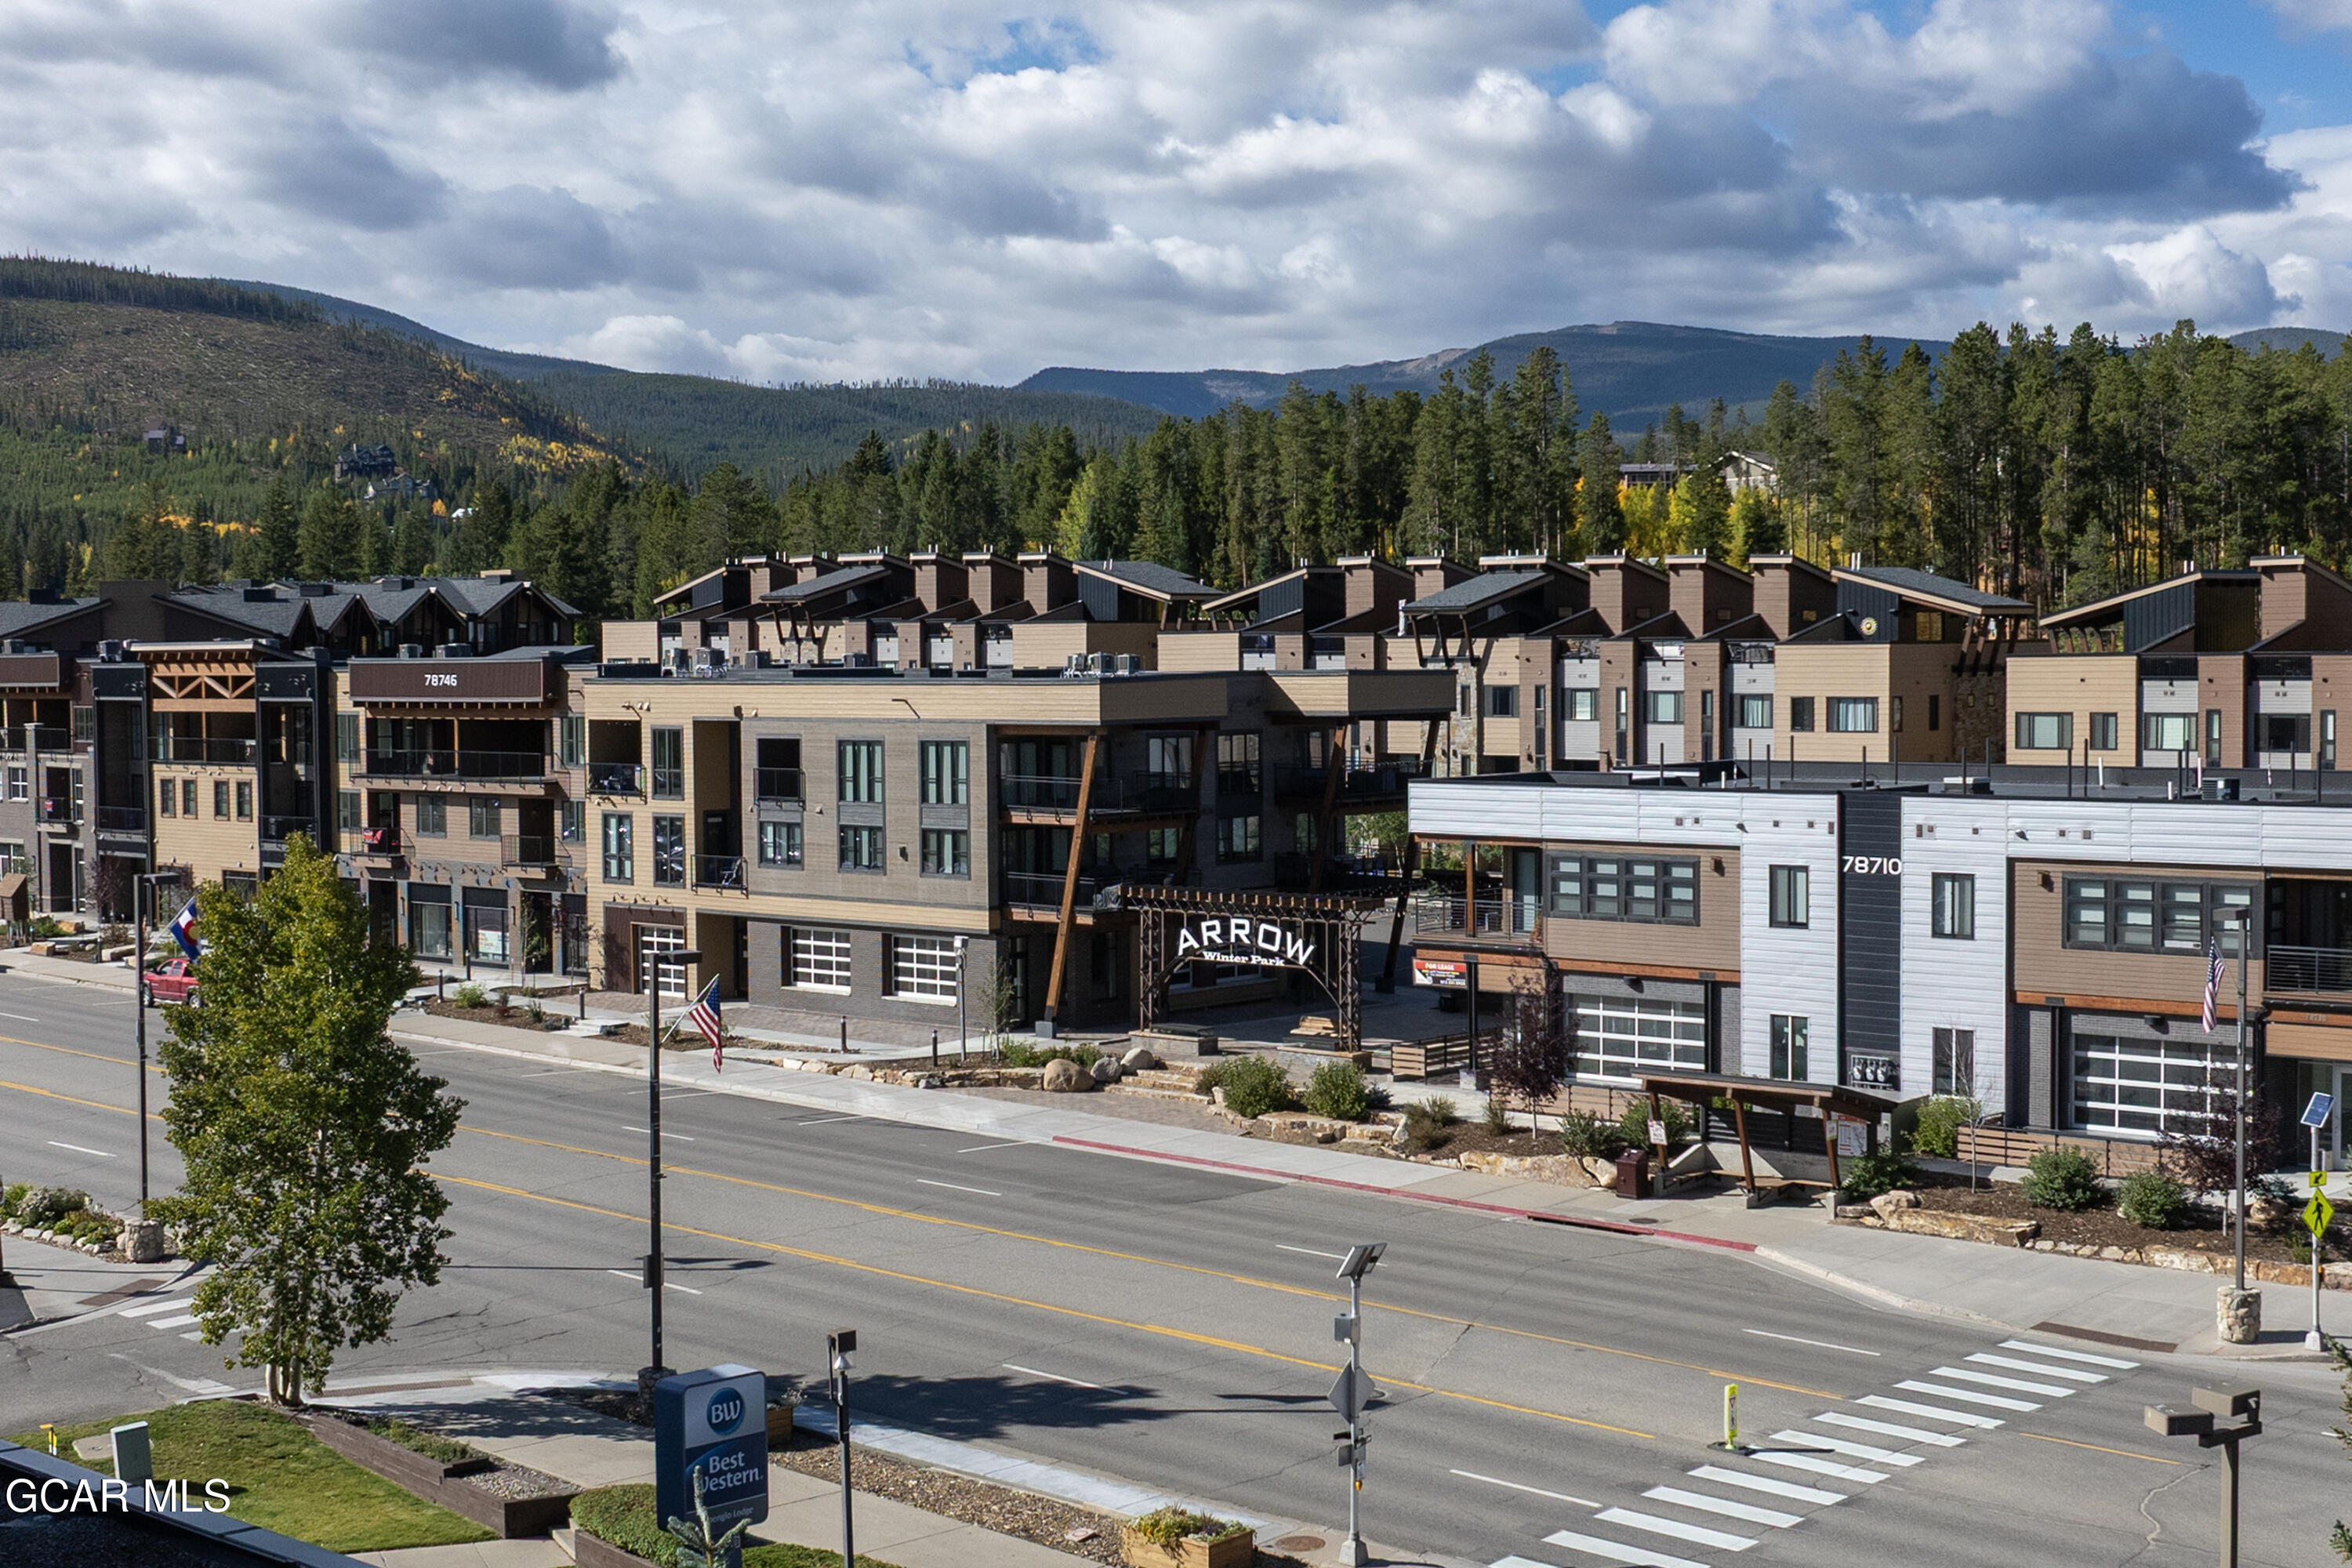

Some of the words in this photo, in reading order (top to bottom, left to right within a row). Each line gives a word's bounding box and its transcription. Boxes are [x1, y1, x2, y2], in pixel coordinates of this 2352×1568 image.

[424, 674, 458, 687] 78746
[1842, 855, 1903, 875] 78710
[1178, 918, 1316, 965] ARROW
[1203, 950, 1249, 964] Winter
[1250, 954, 1286, 966] Park
[711, 1399, 741, 1424] BW
[709, 1451, 745, 1474] Best
[733, 1506, 753, 1518] Lodge
